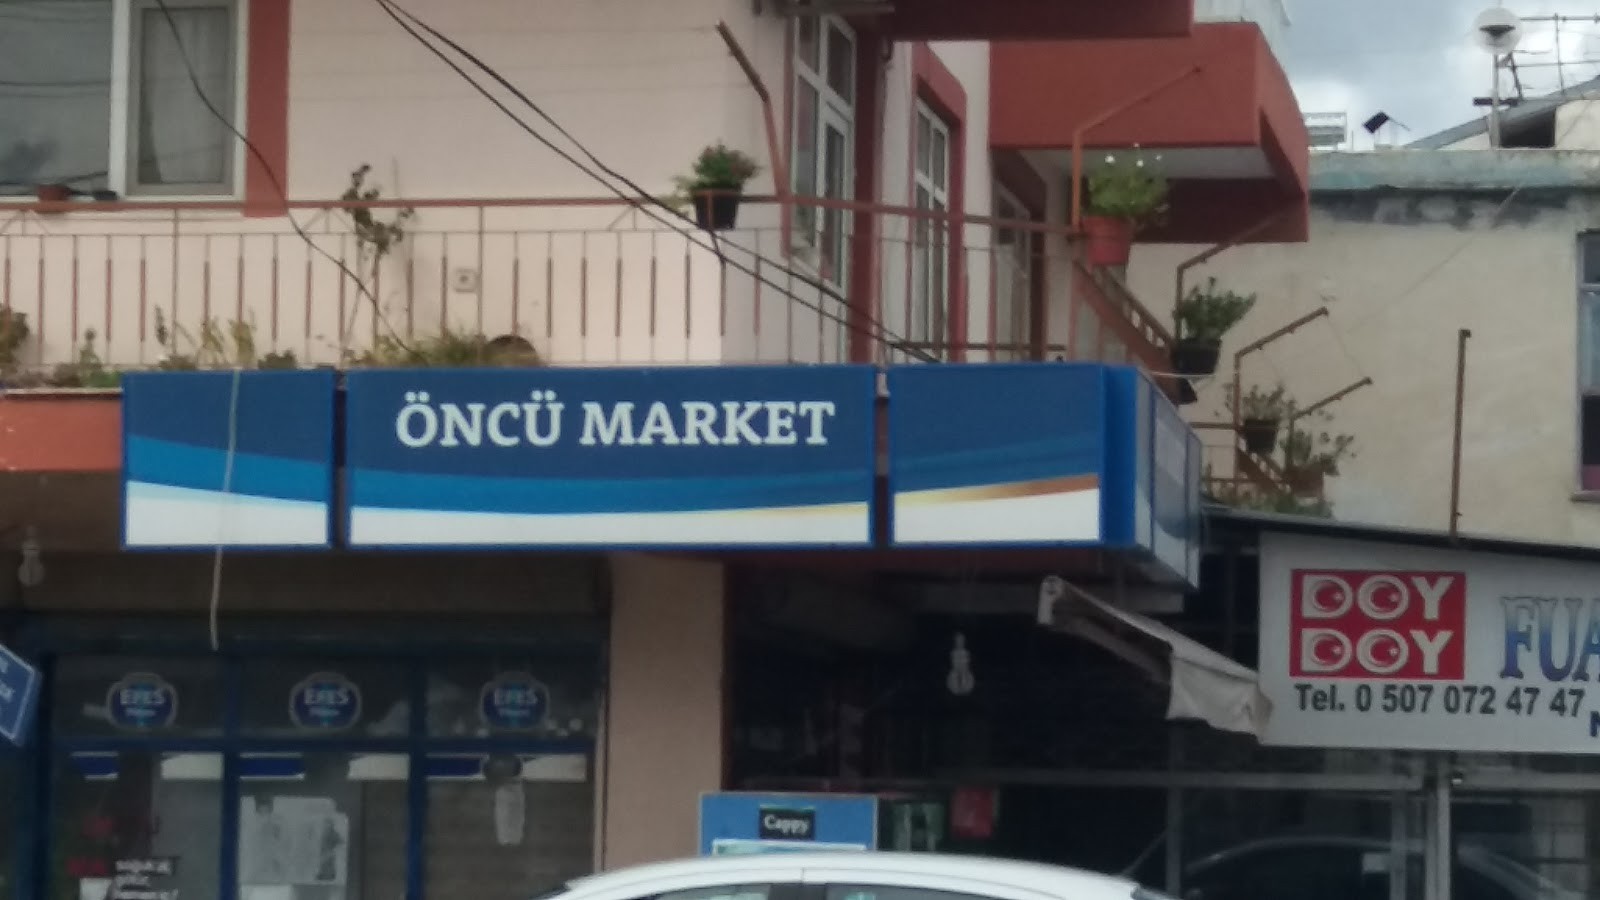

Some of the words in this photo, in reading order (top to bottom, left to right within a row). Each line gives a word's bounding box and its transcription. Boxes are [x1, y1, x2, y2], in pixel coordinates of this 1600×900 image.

[396, 390, 564, 447] ÖNCÜ
[579, 401, 836, 446] MARKET
[1302, 574, 1454, 620] DOY
[1301, 628, 1453, 674] DOY
[1295, 684, 1344, 712] Tel.
[1356, 684, 1372, 712] 0
[1382, 684, 1434, 713] 507
[1444, 686, 1496, 714] 072
[1506, 687, 1540, 715] 47
[1550, 688, 1585, 717] 47
